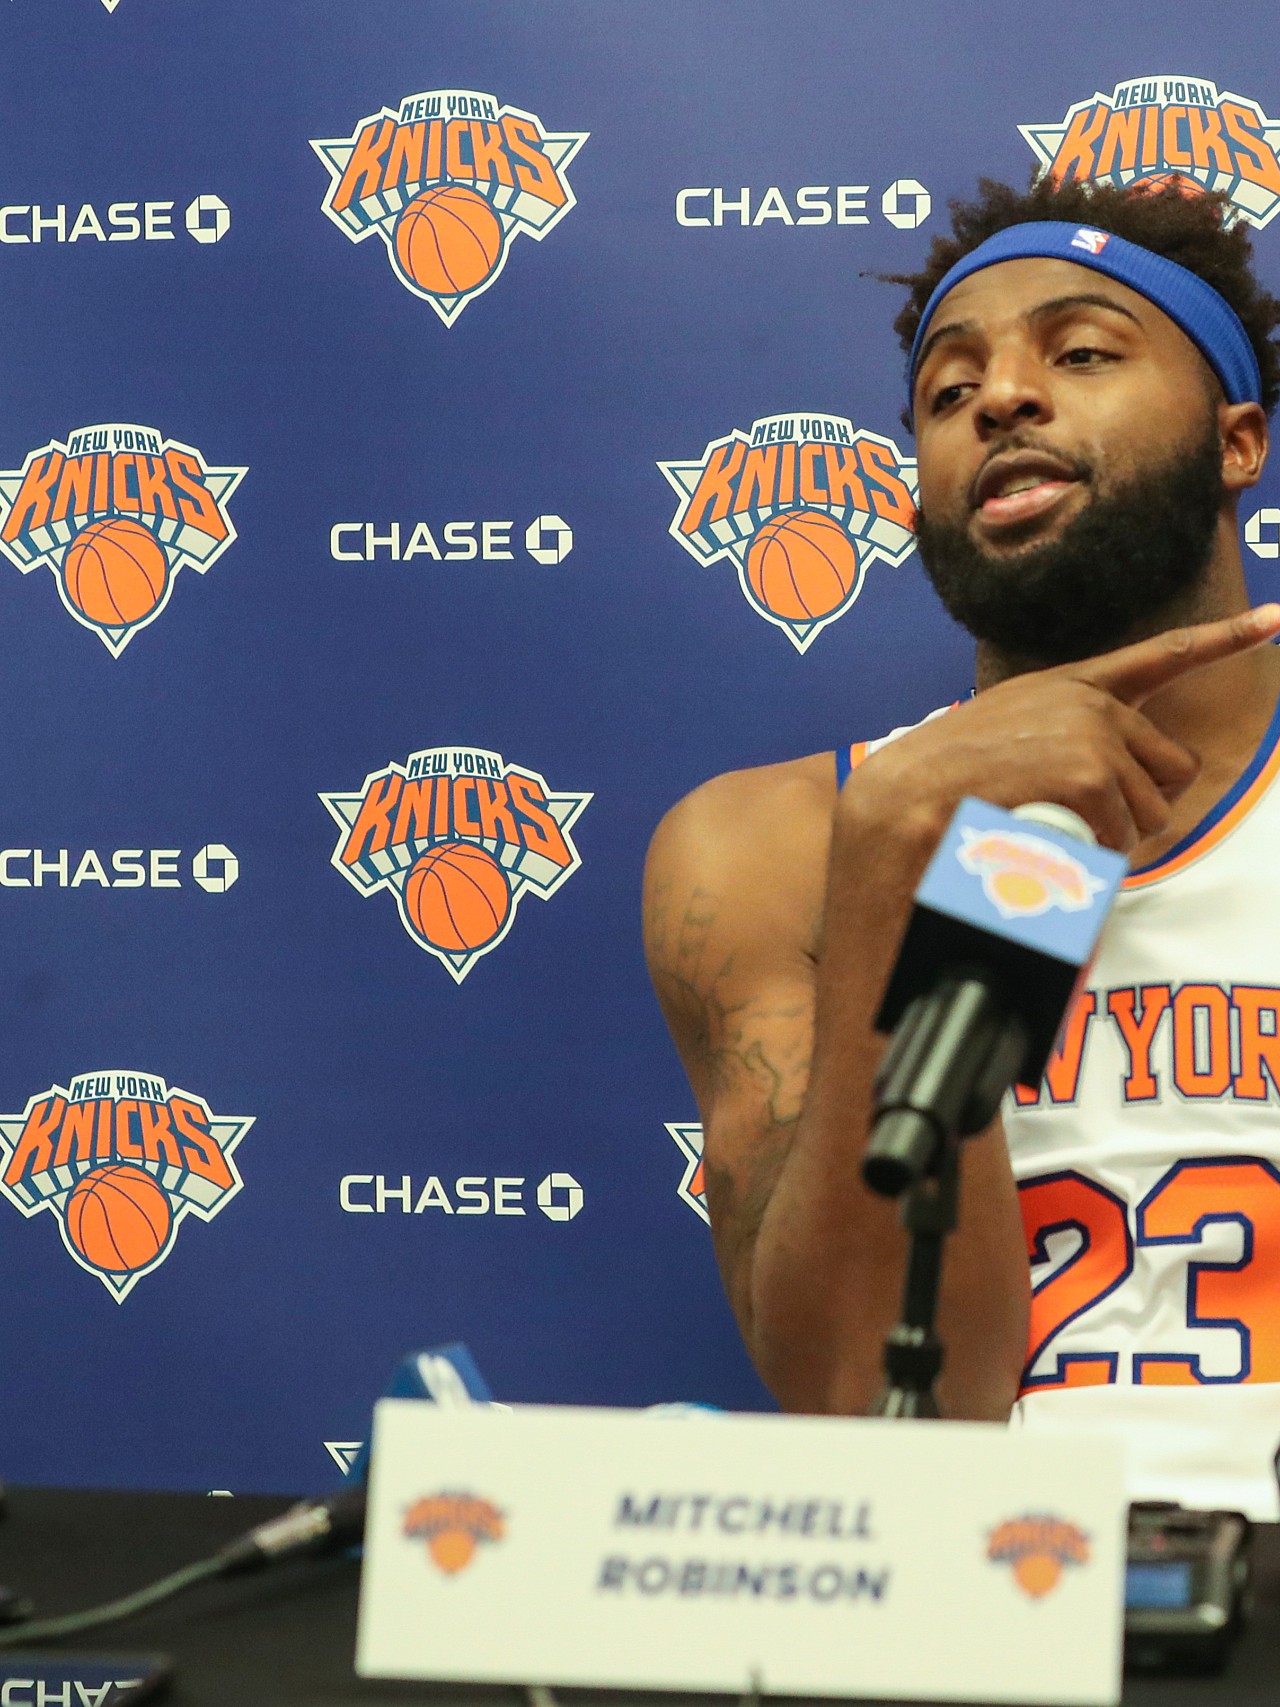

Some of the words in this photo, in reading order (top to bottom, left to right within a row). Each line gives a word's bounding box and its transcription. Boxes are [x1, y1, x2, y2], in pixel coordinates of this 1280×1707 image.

[400, 96, 442, 123] NEW
[447, 95, 497, 121] YORK
[1113, 82, 1158, 109] NEW
[1163, 81, 1215, 107] YORK
[332, 115, 567, 212] KNICKS
[0, 201, 176, 244] CHASE
[675, 185, 871, 227] CHASE
[68, 430, 109, 456] NEW
[113, 429, 161, 454] YORK
[751, 419, 795, 446] NEW
[800, 418, 851, 445] YORK
[2, 449, 228, 543] KNICKS
[681, 440, 917, 536] KNICKS
[330, 520, 515, 562] CHASE
[407, 752, 448, 779] NEW
[452, 752, 502, 779] YORK
[341, 773, 572, 868] KNICKS
[0, 848, 182, 888] CHASE
[70, 1076, 111, 1102] NEW
[116, 1075, 165, 1102] YORK
[4, 1096, 234, 1190] KNICKS
[339, 1174, 527, 1216] CHASE
[613, 1490, 876, 1541] MITCHELL
[596, 1556, 889, 1603] ROBINSON
